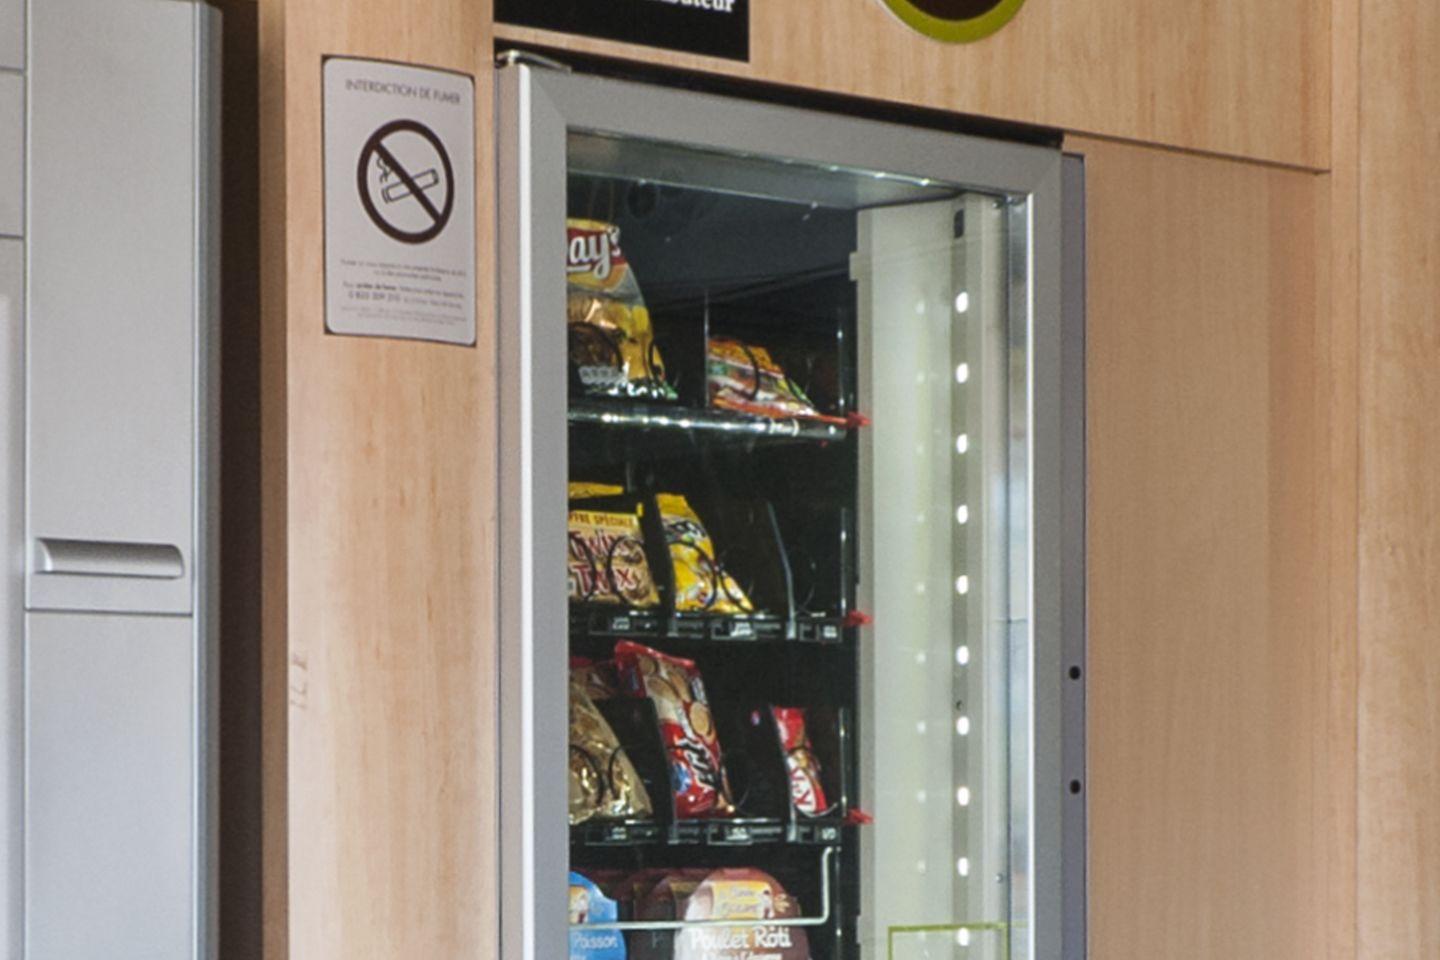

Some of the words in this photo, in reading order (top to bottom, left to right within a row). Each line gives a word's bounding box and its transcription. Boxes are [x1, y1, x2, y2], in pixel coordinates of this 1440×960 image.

[345, 79, 417, 98] INTERDICTION
[420, 88, 431, 100] DE
[688, 926, 749, 949] Poulet
[753, 924, 792, 949] Rôti
